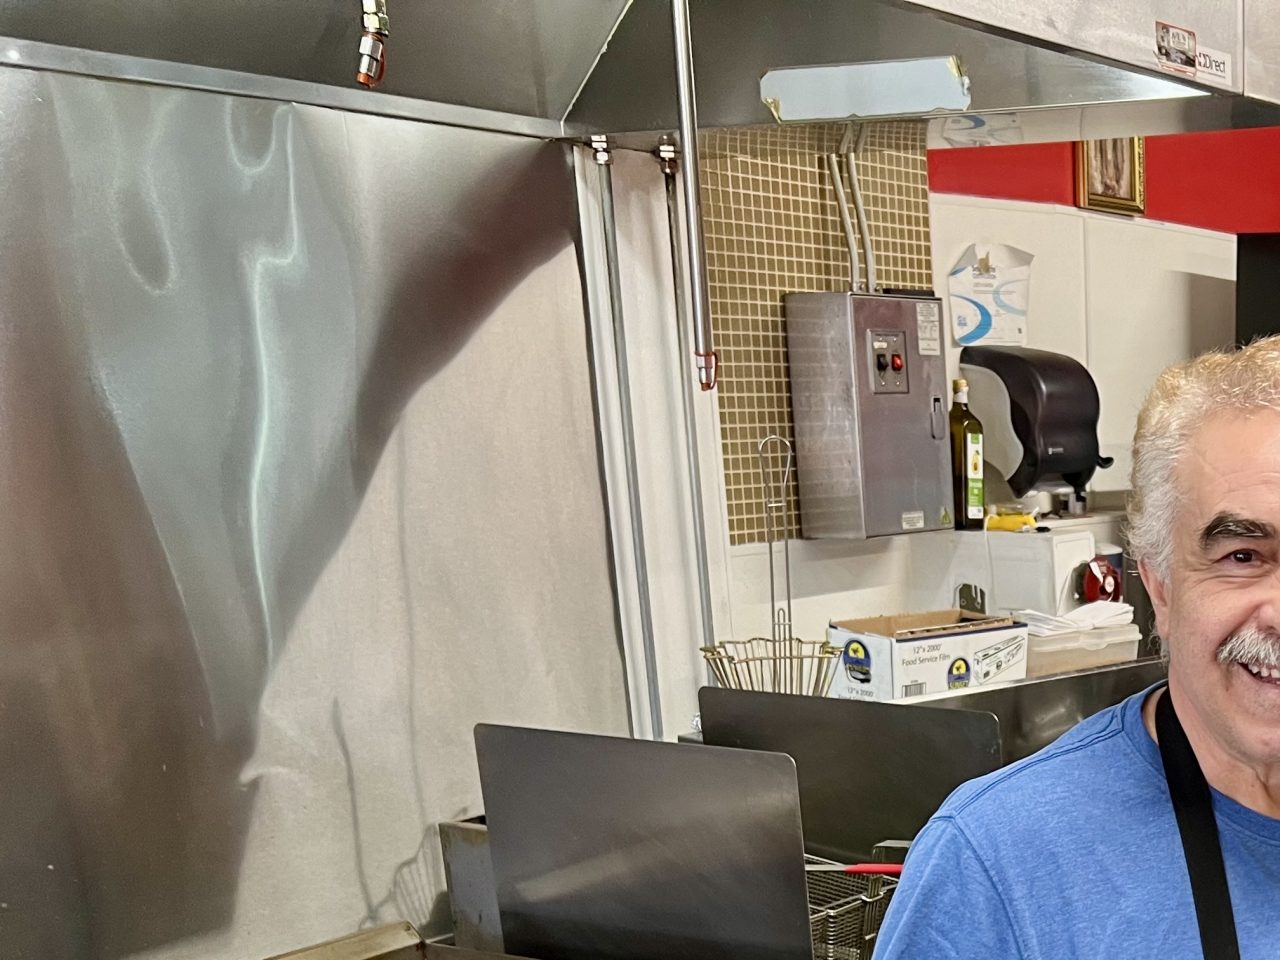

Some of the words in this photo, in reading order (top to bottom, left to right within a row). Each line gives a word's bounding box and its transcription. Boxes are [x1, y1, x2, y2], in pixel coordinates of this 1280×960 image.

[902, 658, 917, 667] Food
[918, 655, 938, 665] Service
[939, 653, 951, 661] Film
